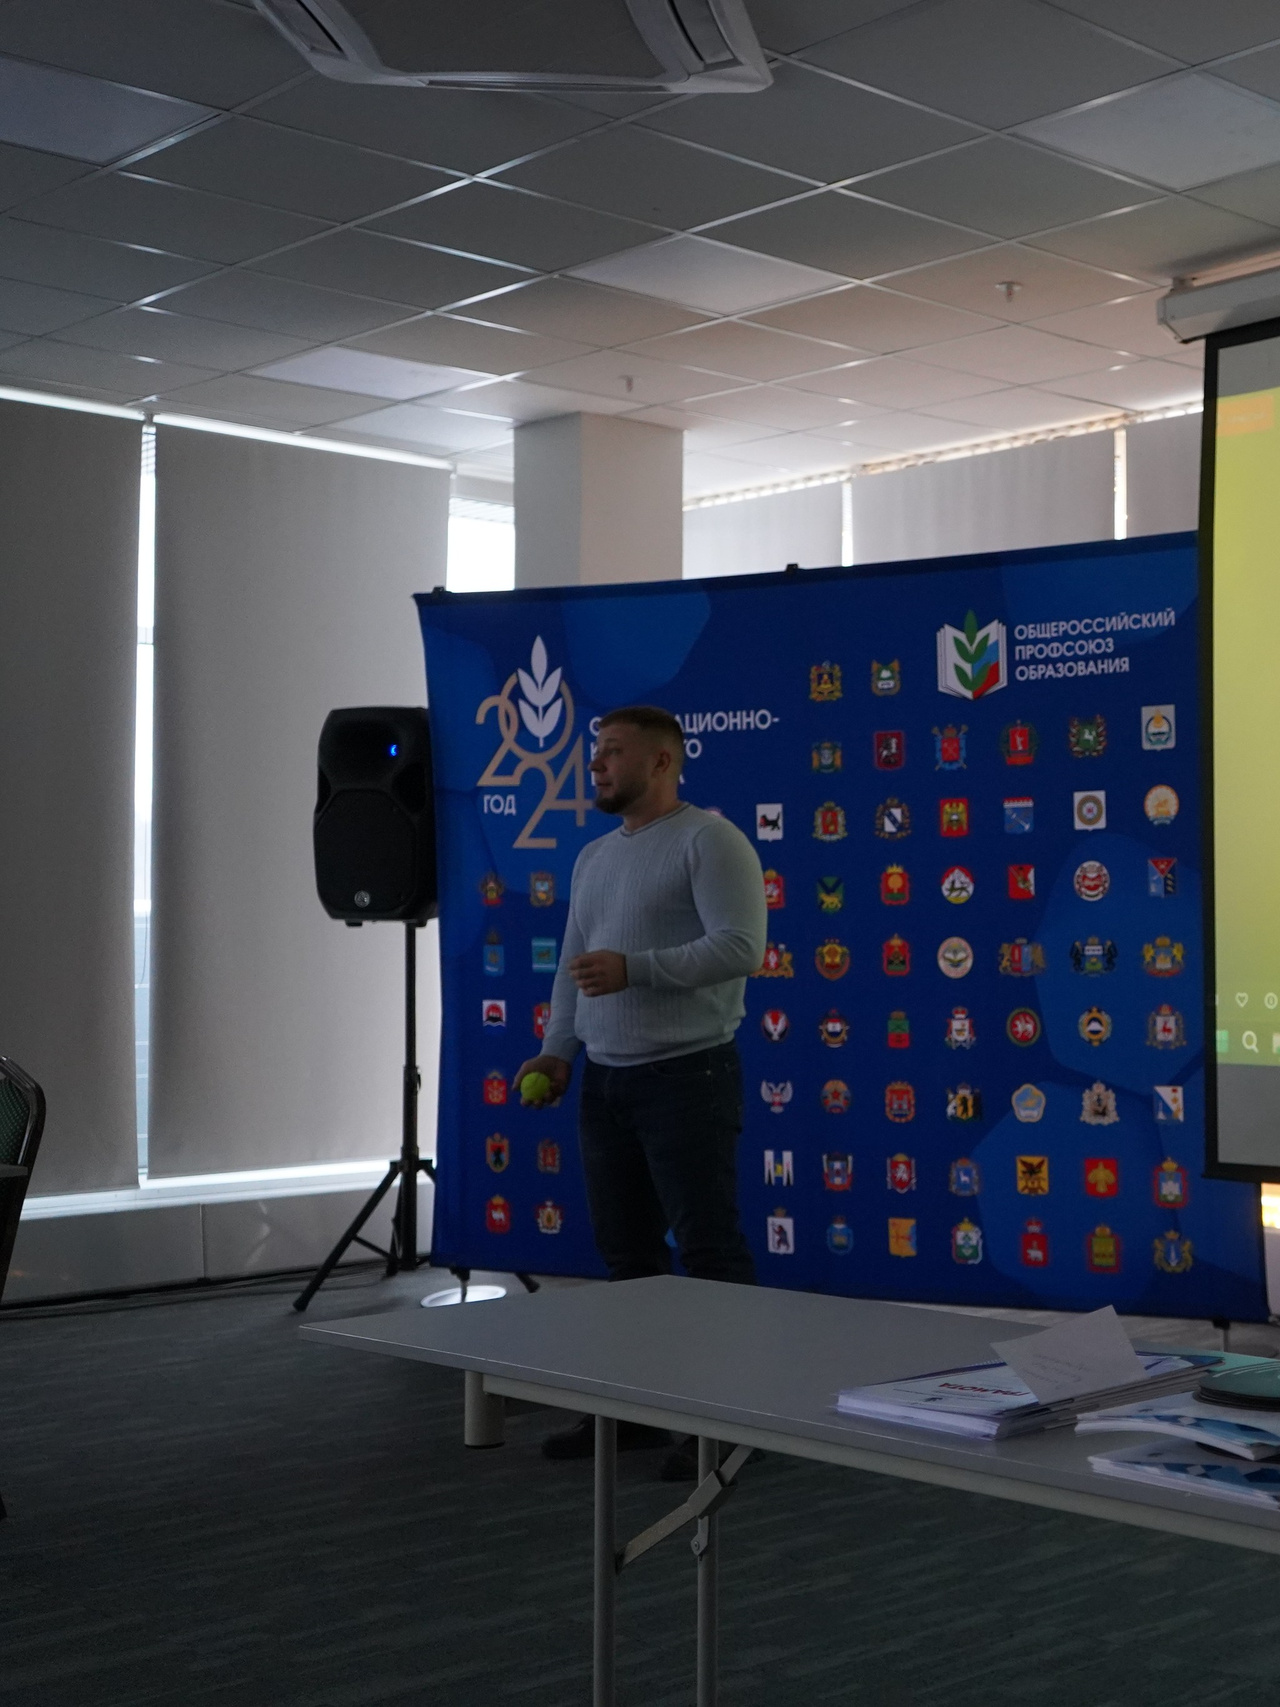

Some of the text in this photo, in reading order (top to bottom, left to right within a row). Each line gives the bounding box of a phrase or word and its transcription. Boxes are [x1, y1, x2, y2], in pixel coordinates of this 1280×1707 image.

[1014, 608, 1175, 640] ОБЩЕРОССИЙСКИЙ
[1015, 637, 1114, 661] ПРОФСОЮЗ
[1015, 657, 1129, 681] ОБРАЗОВАНИЯ
[483, 794, 517, 816] ГОД
